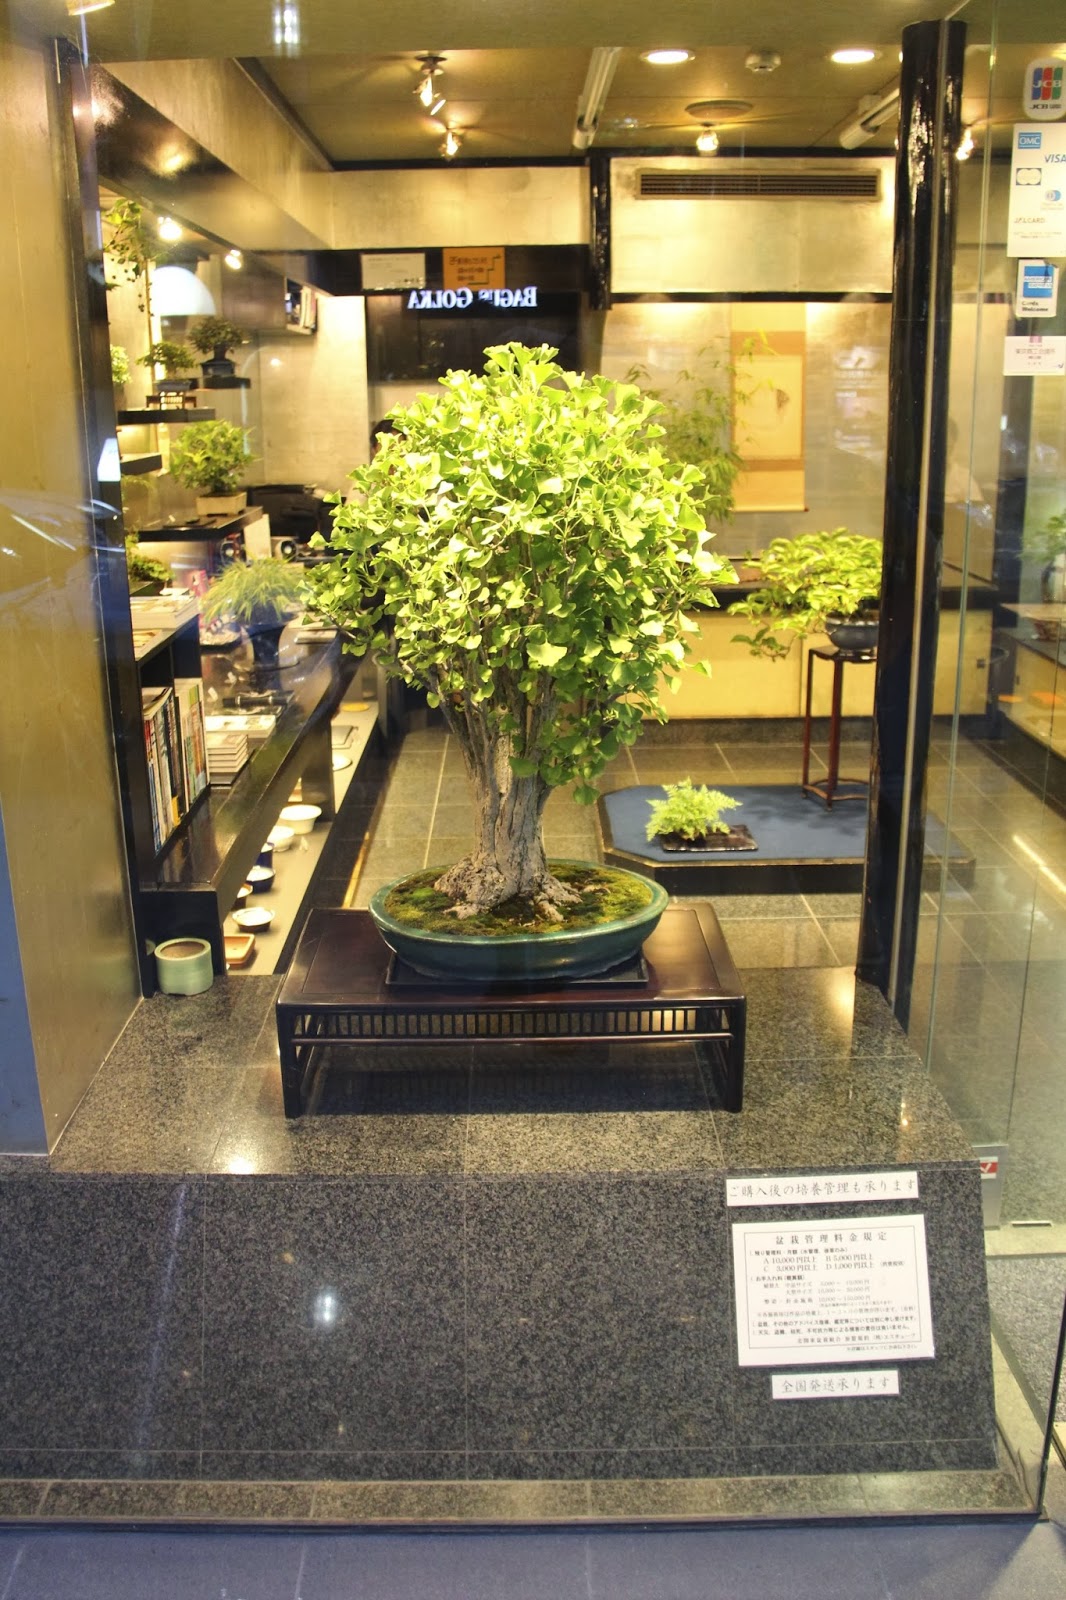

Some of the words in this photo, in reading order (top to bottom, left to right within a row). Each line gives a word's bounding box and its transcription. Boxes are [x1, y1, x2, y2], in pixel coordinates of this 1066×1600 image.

[1032, 80, 1061, 88] JCB
[1020, 136, 1040, 145] OMC
[1044, 154, 1066, 163] VISA
[729, 1178, 916, 1198] ご購入後の培養管理も承ります
[782, 1377, 891, 1393] 全国発送承ります
